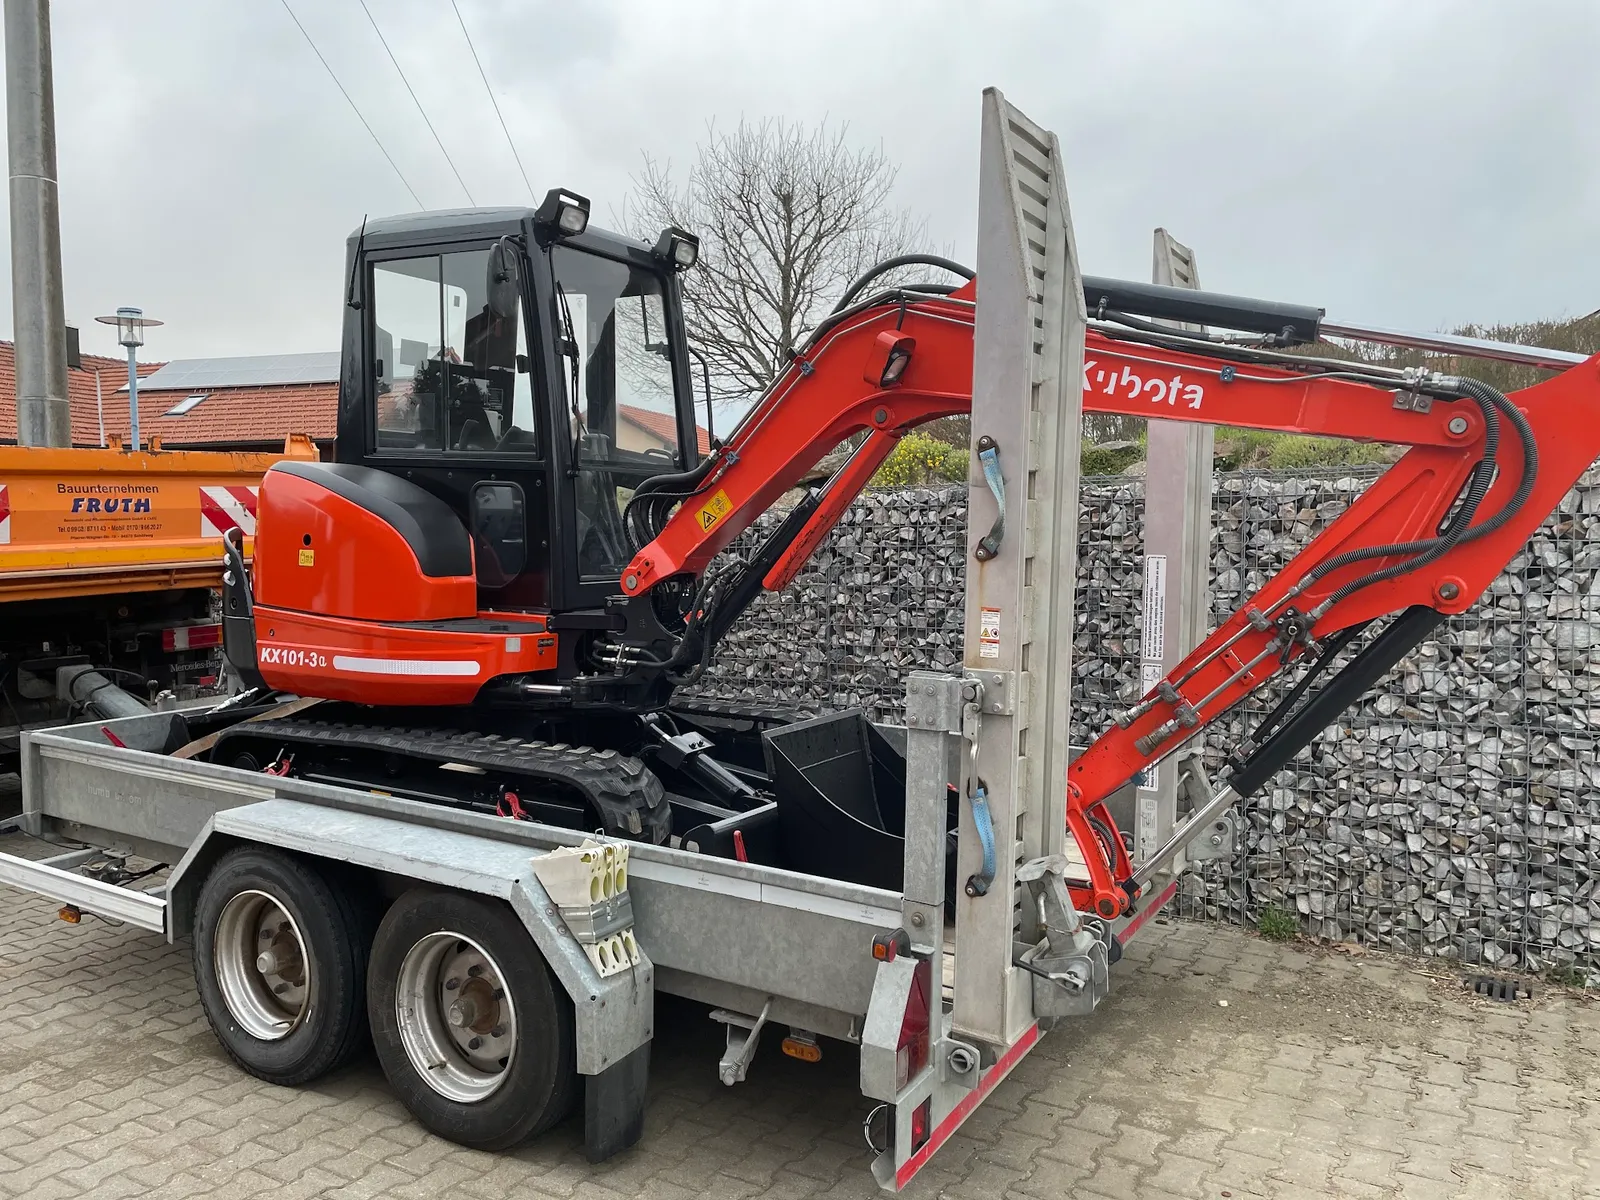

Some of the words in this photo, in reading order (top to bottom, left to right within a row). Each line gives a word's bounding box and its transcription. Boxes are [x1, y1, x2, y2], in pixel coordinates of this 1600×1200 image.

[1083, 361, 1204, 409] Kubota
[57, 483, 159, 494] Bauunternehmen
[71, 498, 151, 513] FRUTH
